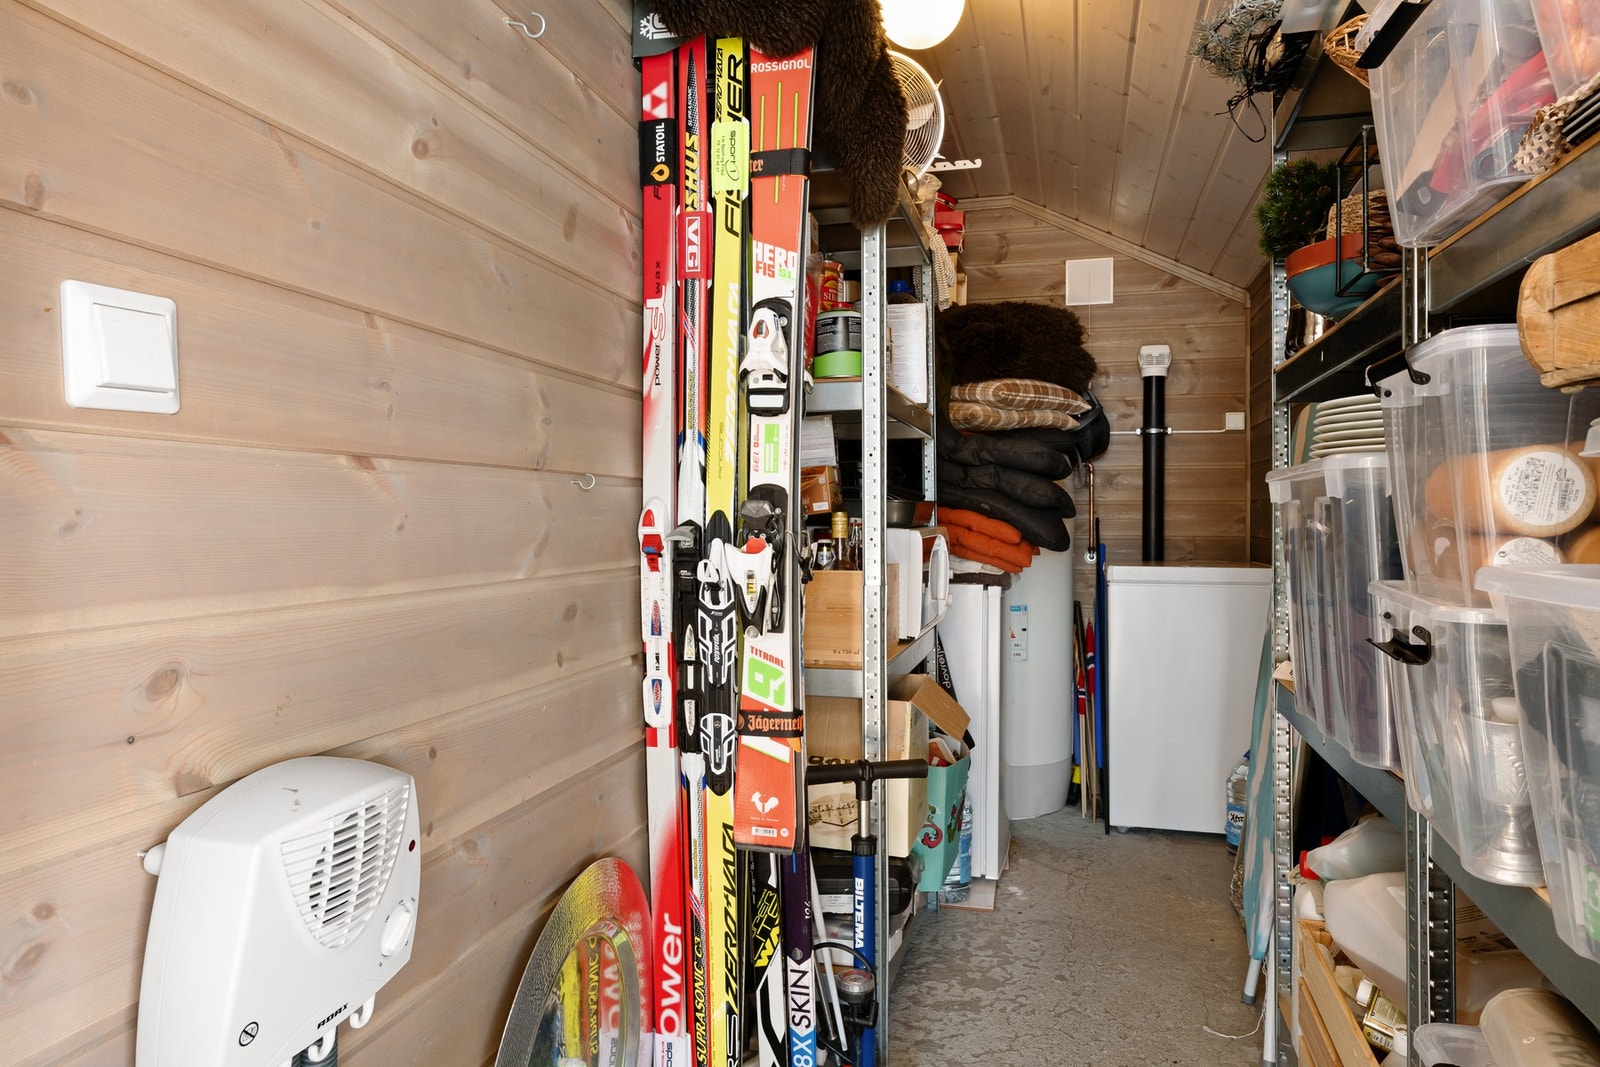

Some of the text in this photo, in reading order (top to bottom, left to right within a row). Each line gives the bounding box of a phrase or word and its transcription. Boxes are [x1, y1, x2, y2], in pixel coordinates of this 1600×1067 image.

[751, 59, 811, 73] ROSSIGNOL
[656, 122, 665, 163] STATOIL
[729, 130, 737, 165] sport
[687, 219, 699, 271] VG
[755, 261, 775, 278] FIS
[750, 645, 785, 669] TITANAL
[748, 715, 804, 732] Jägermei
[854, 877, 864, 949] BILTEMA
[659, 912, 682, 1037] ower
[694, 936, 707, 1065] SUPRASONIC C3
[790, 968, 811, 1029] SKIN
